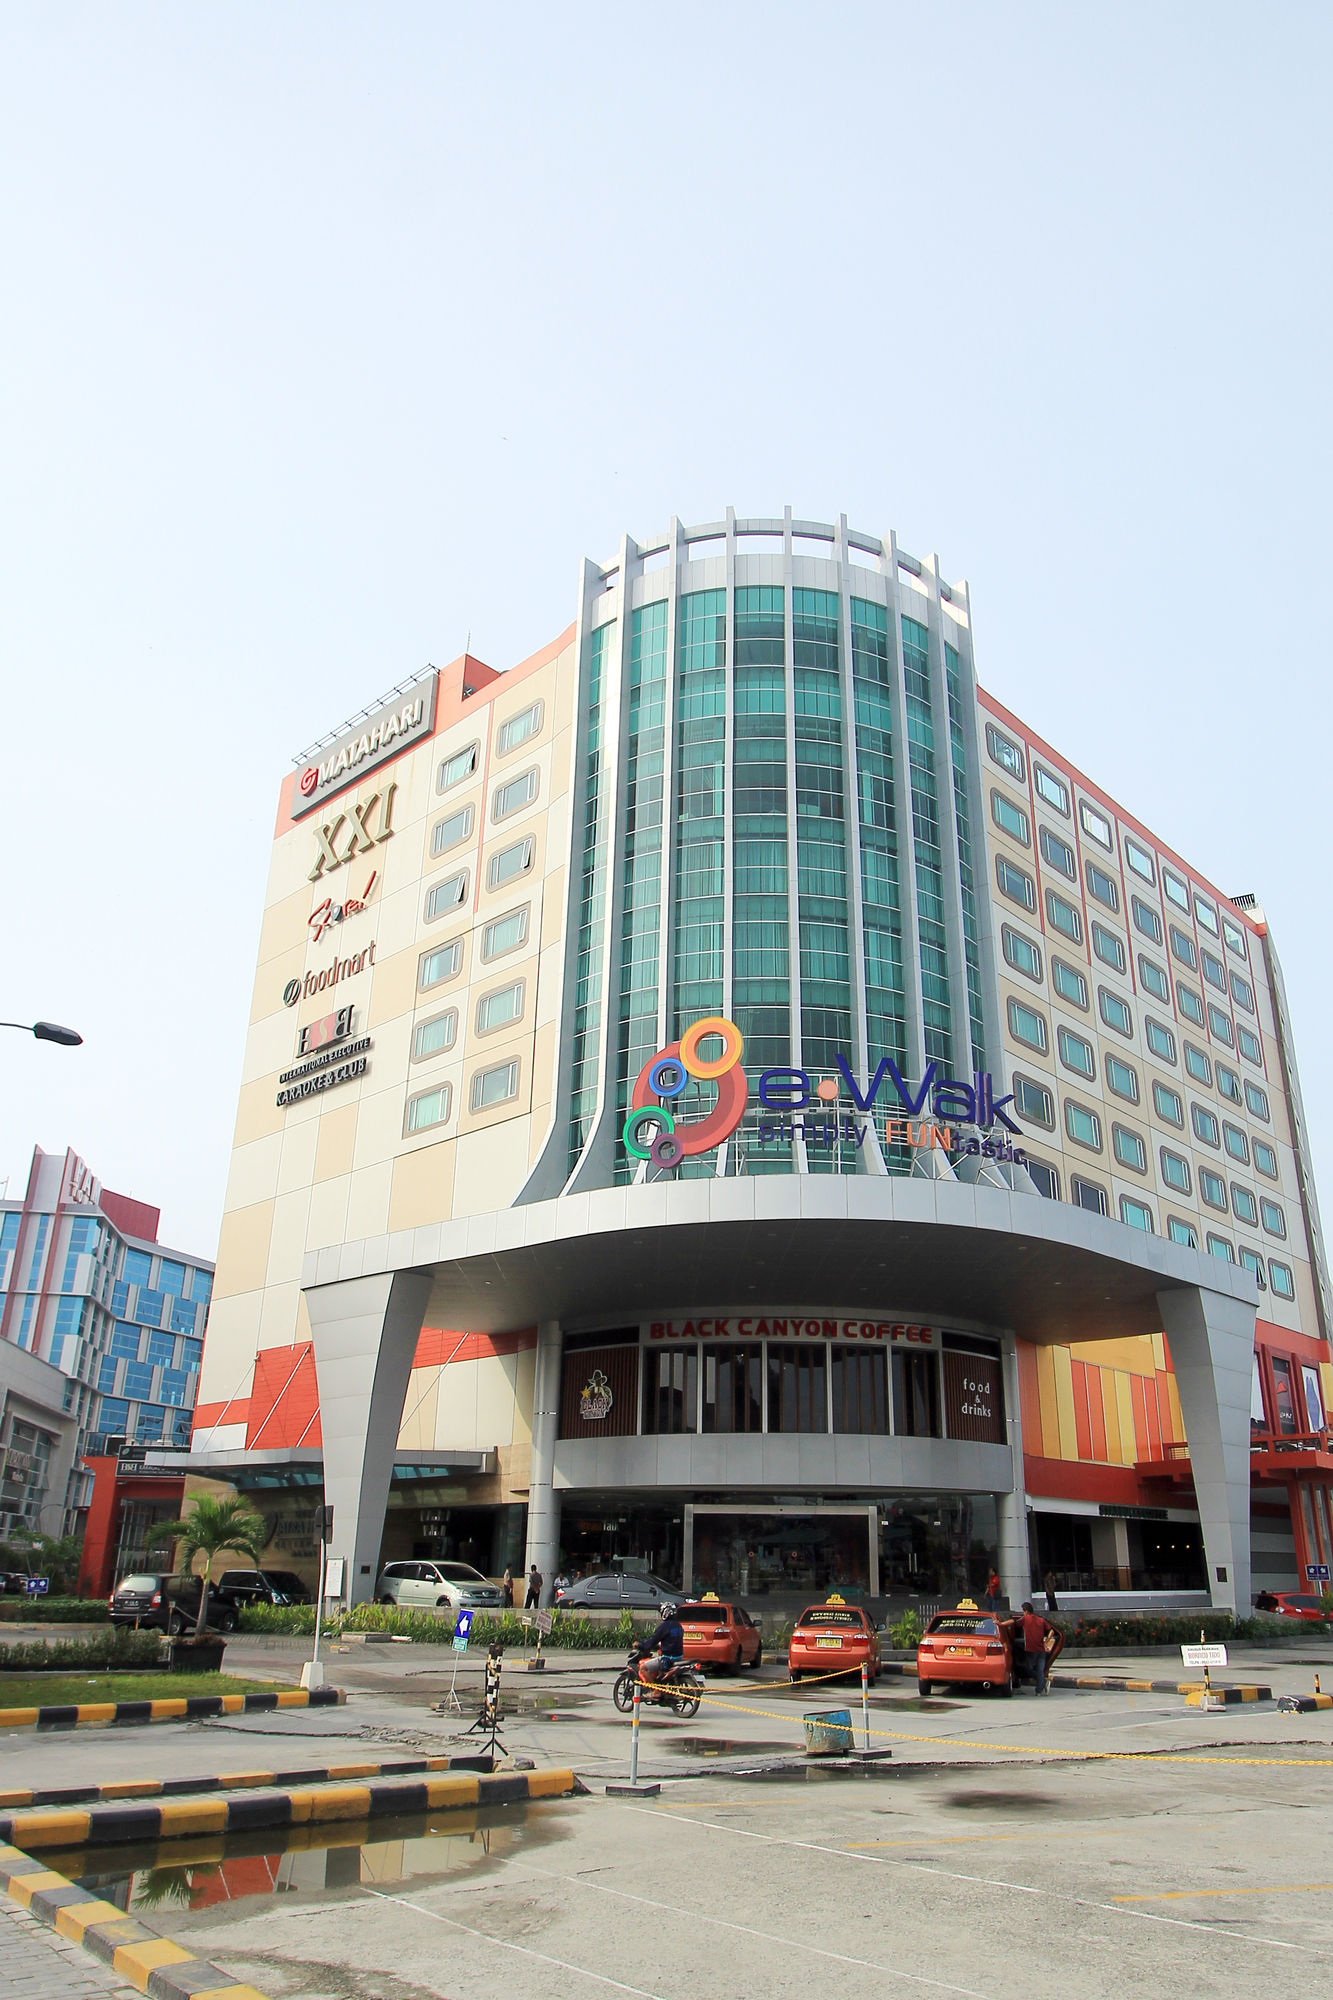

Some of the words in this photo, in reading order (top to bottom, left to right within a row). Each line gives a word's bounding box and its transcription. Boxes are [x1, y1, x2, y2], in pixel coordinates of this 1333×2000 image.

[318, 697, 424, 787] MATAHARI
[308, 782, 398, 881] XXI
[301, 939, 377, 1002] foodmart
[276, 1074, 327, 1107] KARAOKE
[325, 1070, 336, 1088] &
[335, 1057, 367, 1083] CLUB
[279, 1053, 329, 1083] INTERNATIONAL
[328, 1036, 372, 1062] EXECUTIVE
[759, 1116, 868, 1148] simply
[885, 1120, 1028, 1166] FUNtastic
[649, 1319, 730, 1340] BLACK
[738, 1318, 839, 1338] CANYON
[843, 1321, 933, 1345] COFFEE
[582, 1397, 609, 1411] BLACK
[963, 1378, 990, 1394] food
[975, 1394, 981, 1403] &
[961, 1402, 992, 1418] drinks
